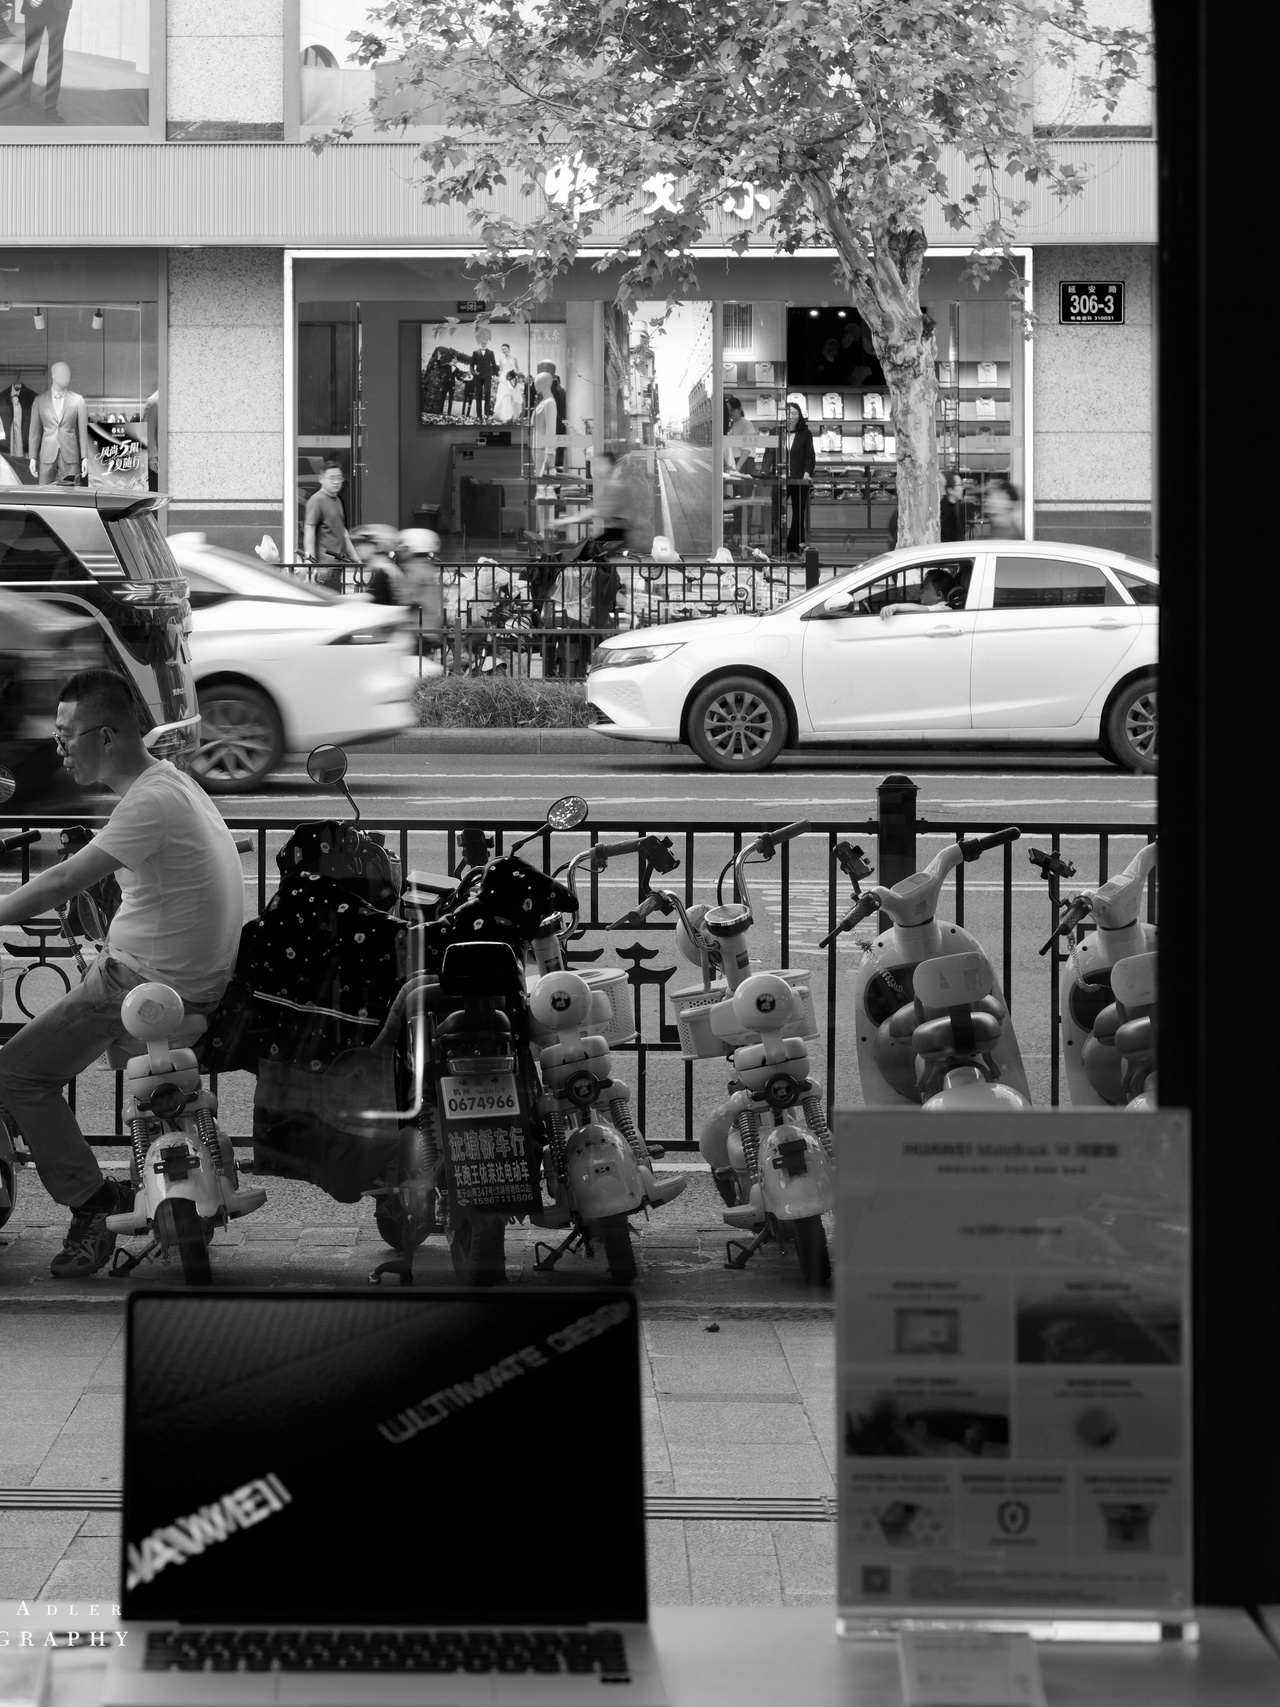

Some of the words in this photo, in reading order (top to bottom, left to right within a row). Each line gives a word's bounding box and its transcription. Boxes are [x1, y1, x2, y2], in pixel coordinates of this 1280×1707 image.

[1068, 285, 1117, 294] 延安路
[1070, 294, 1114, 314] 306-3
[448, 1095, 515, 1112] 0674966
[448, 1126, 525, 1162] 沈塘桥车行
[454, 1160, 530, 1187] 长跑王依莱达电动车
[377, 1345, 549, 1444] ULTIMATE
